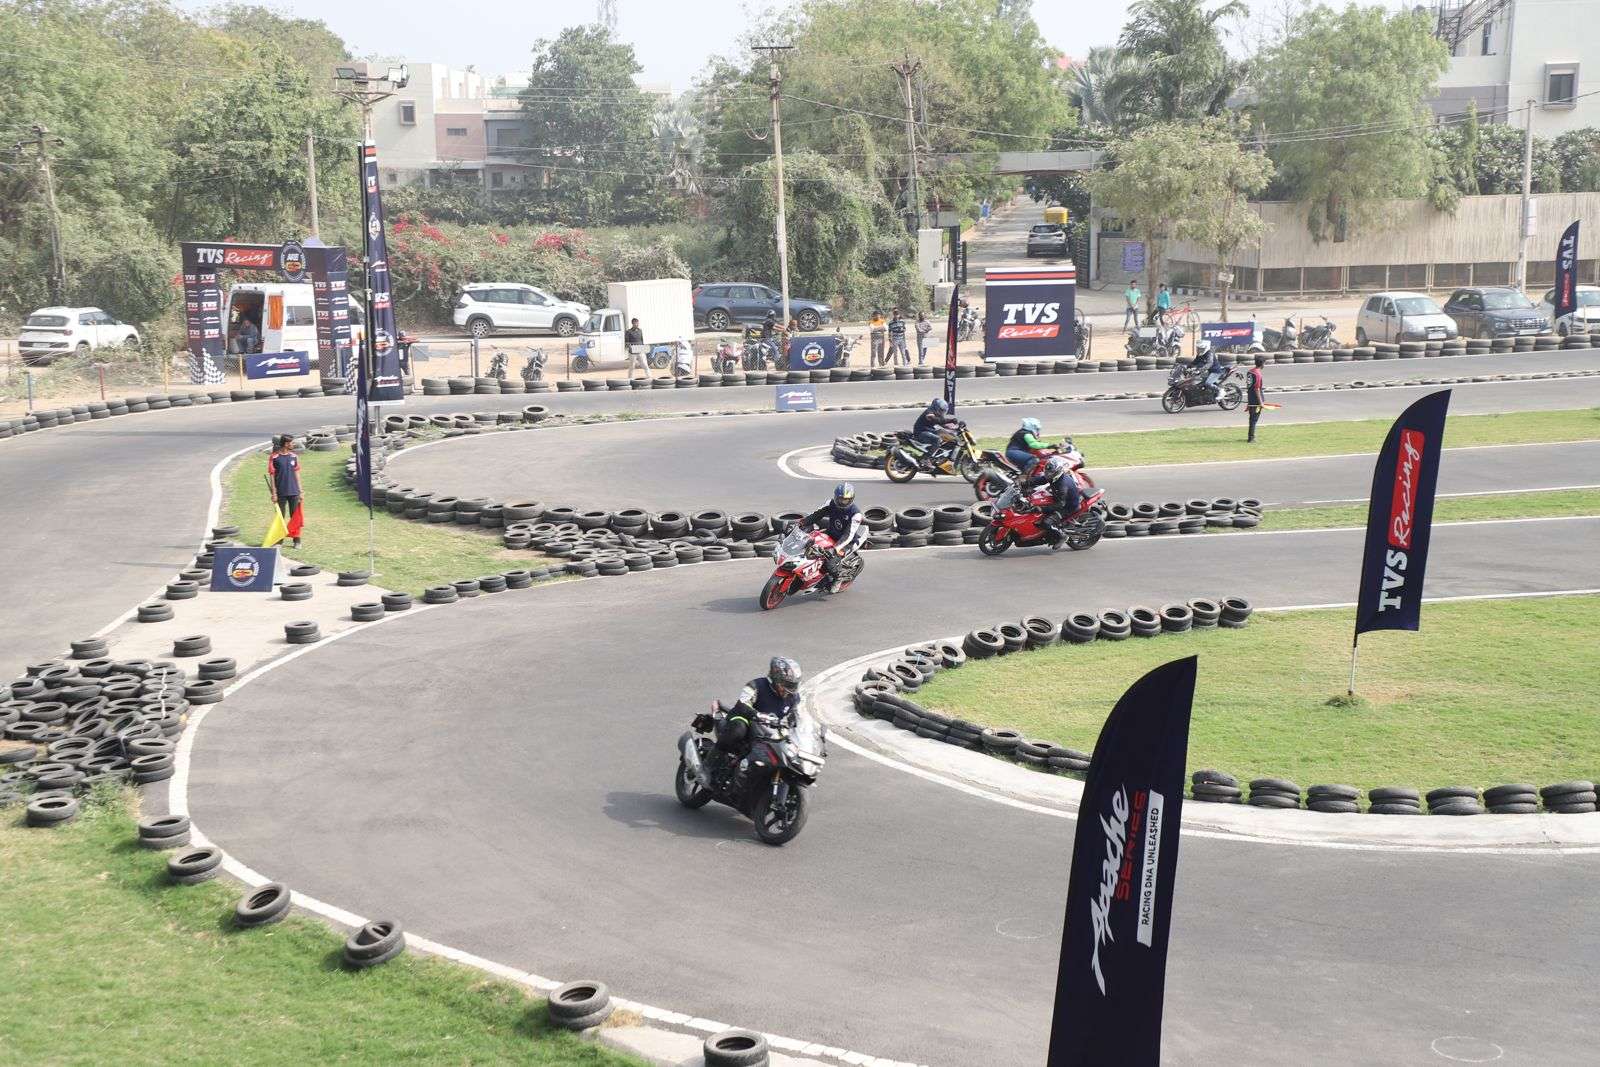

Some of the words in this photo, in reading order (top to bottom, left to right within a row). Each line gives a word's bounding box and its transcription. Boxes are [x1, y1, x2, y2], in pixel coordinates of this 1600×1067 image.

[197, 248, 224, 264] TVS
[225, 251, 272, 265] Racing
[1563, 236, 1574, 269] TVS
[1003, 303, 1060, 324] TVS
[1379, 550, 1408, 612] TVS
[1394, 432, 1421, 546] Racing
[1147, 808, 1160, 866] UNLEASHED
[1091, 784, 1130, 997] Apache
[1145, 868, 1154, 888] DNA
[1142, 891, 1152, 925] RACING
